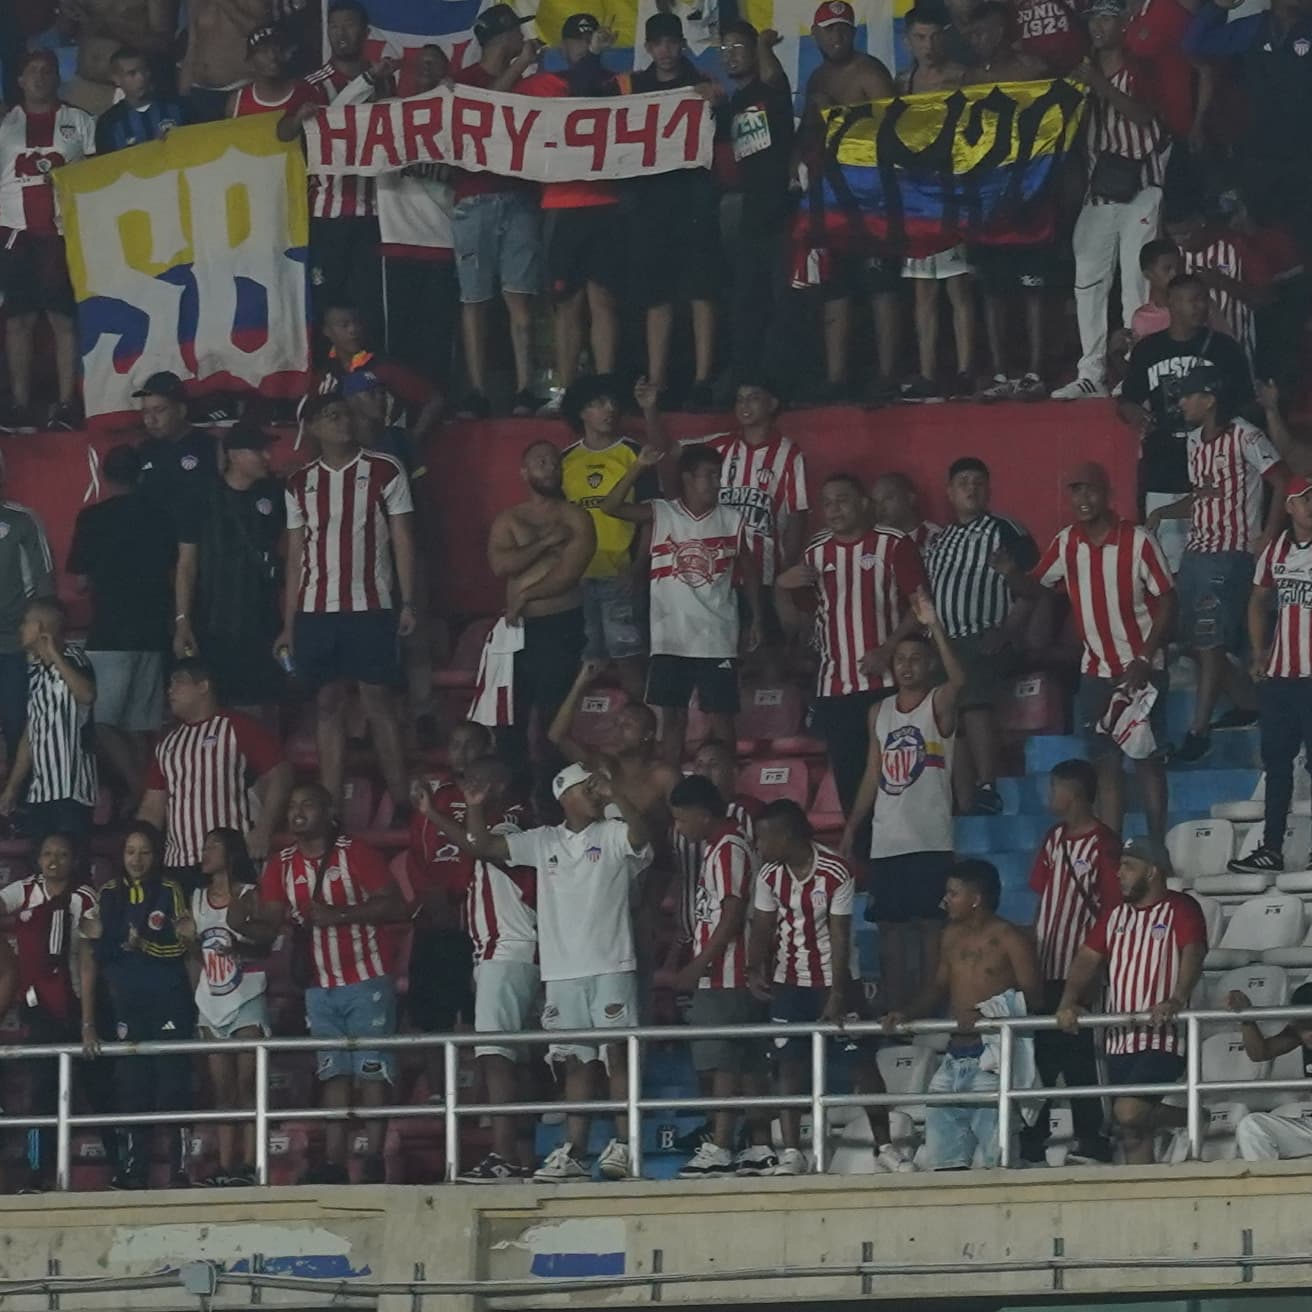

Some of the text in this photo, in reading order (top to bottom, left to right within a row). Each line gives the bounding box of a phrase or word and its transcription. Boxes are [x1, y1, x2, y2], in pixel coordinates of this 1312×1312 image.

[1022, 13, 1069, 39] 1924
[317, 95, 706, 173] HARRY-941
[661, 1130, 675, 1150] B
